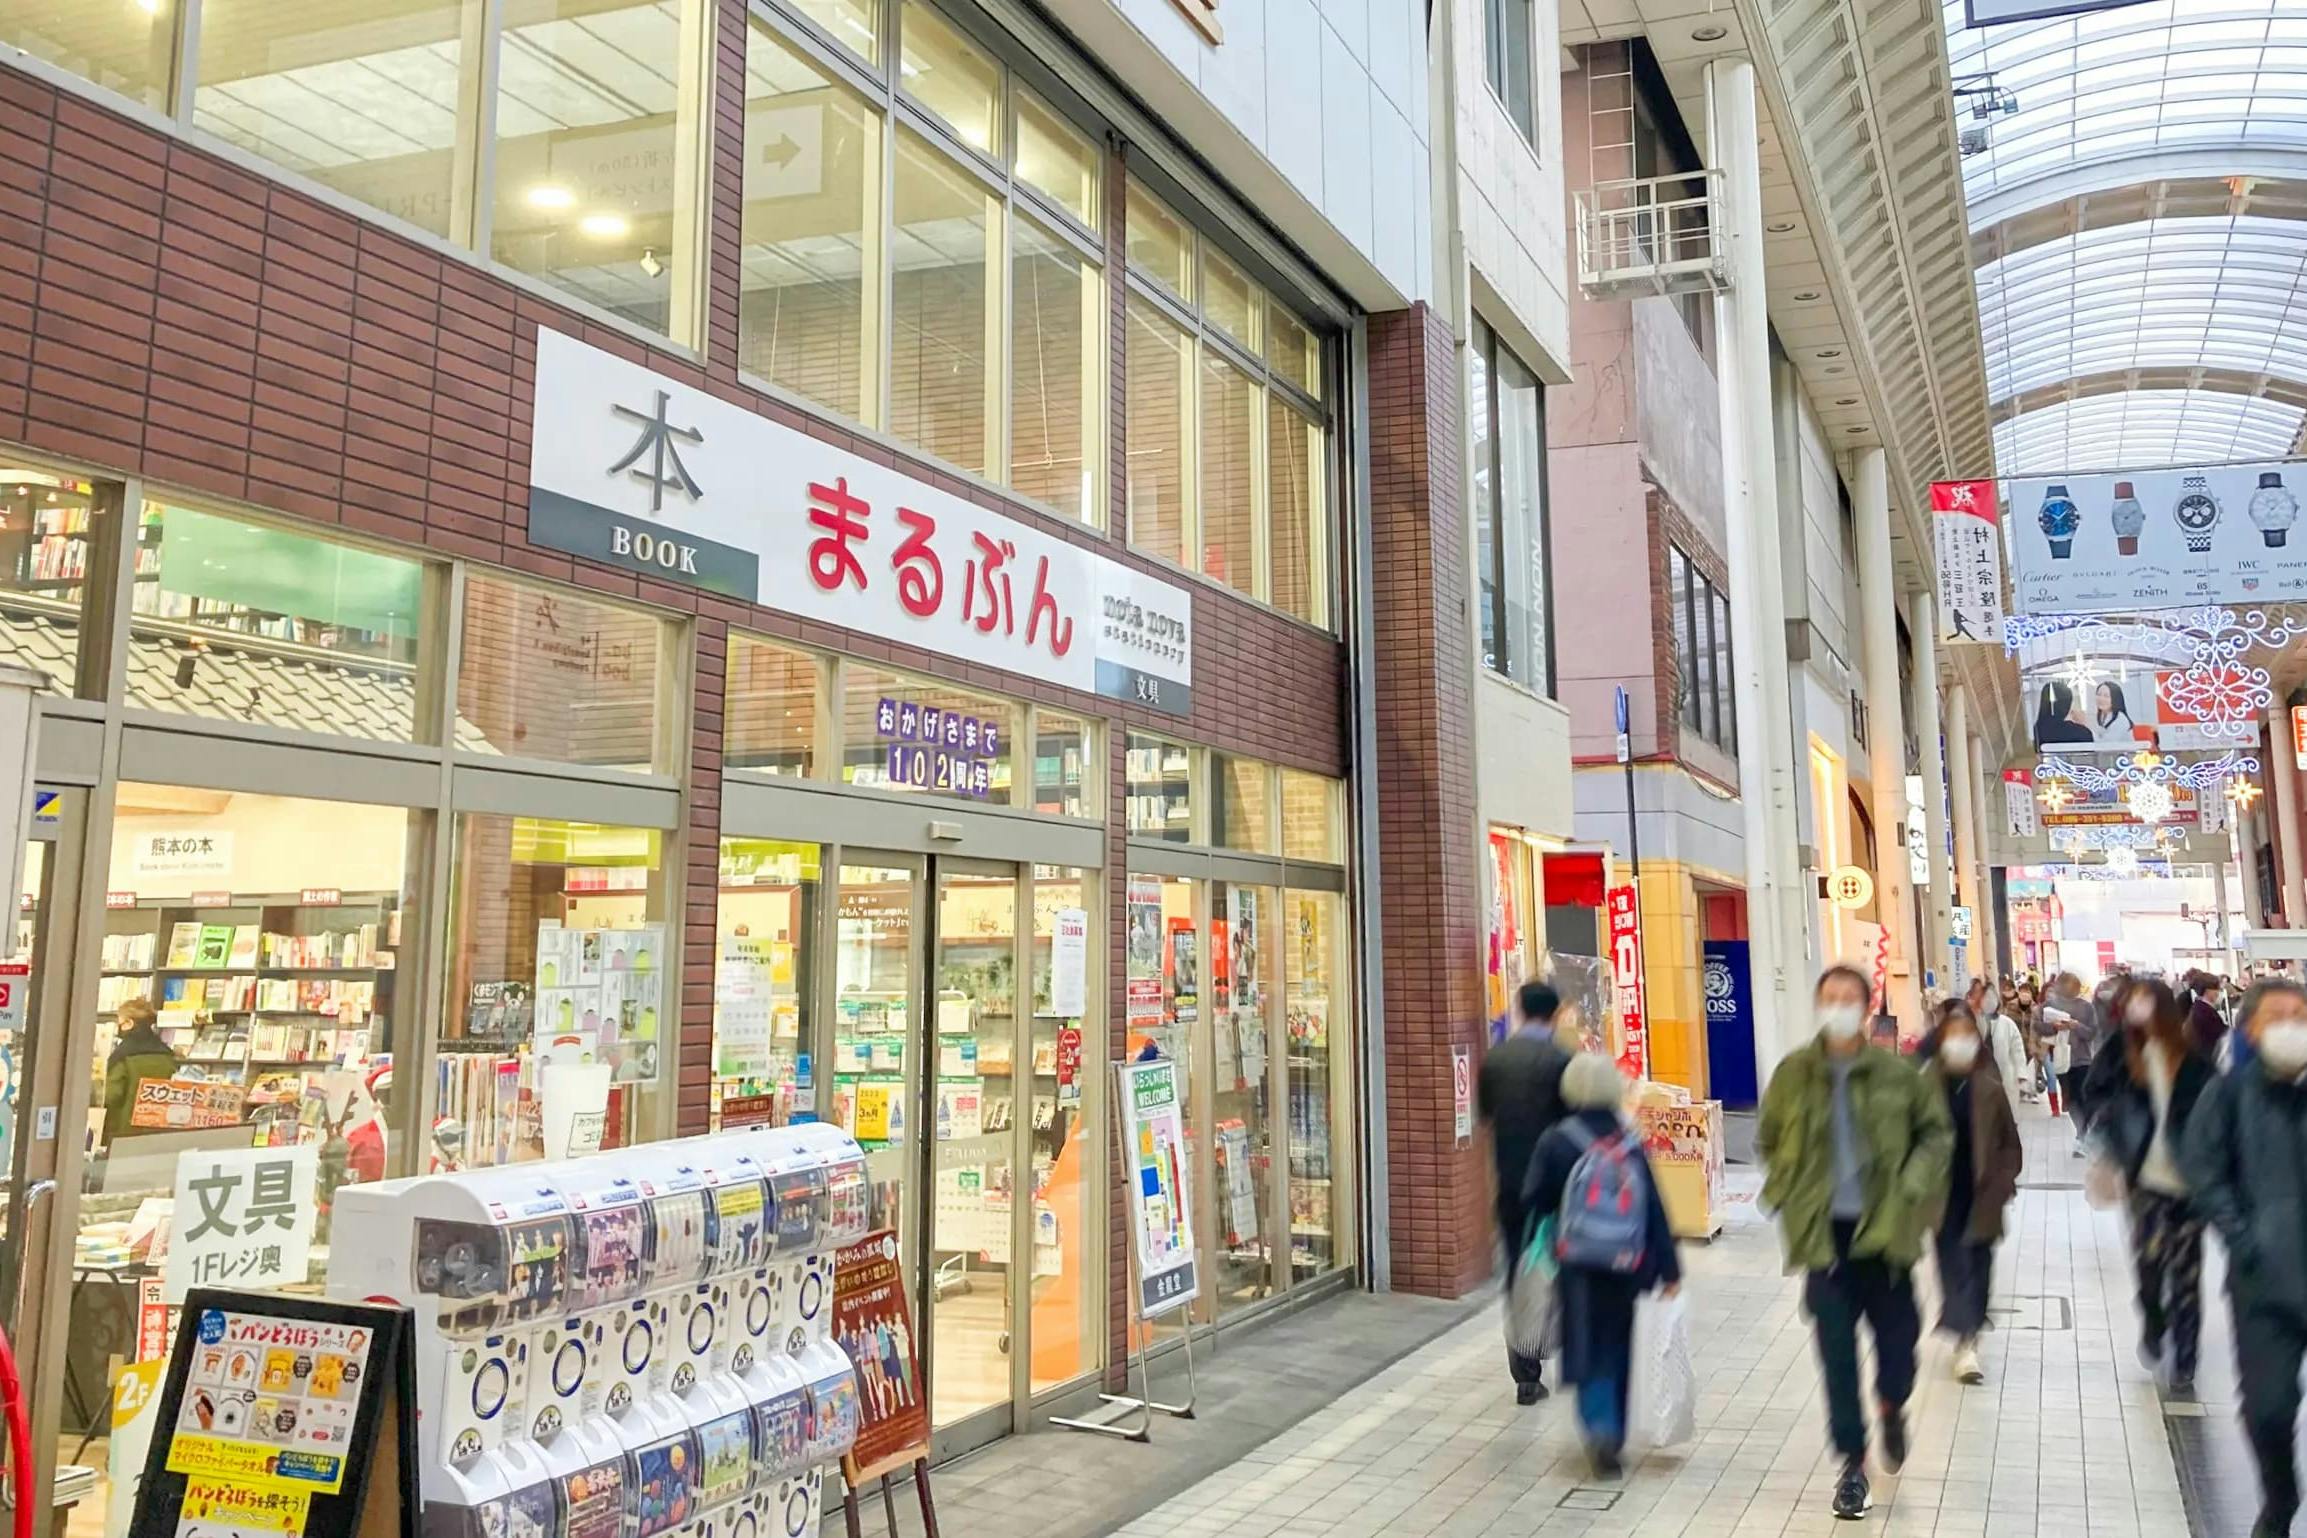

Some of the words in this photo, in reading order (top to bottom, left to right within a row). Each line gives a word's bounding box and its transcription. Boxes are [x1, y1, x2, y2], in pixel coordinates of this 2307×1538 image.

[608, 389, 703, 511] 本
[610, 526, 698, 575] BOOK
[808, 477, 1071, 657] まるぶん
[2022, 571, 2063, 583] Cartier
[2238, 560, 2258, 570] IWC
[1972, 526, 1996, 638] 村上宗隆選手
[2133, 588, 2168, 598] ZENITH
[1103, 595, 1144, 629] nota
[2028, 595, 2060, 604] OMEGA
[1136, 675, 1159, 704] 文具
[880, 703, 997, 753] おかげさまで
[894, 746, 987, 793] 102周年
[150, 836, 214, 857] 熊本の本
[1706, 1000, 1737, 1013] OSS
[142, 1083, 204, 1105] スウェット
[1137, 1087, 1173, 1107] WELCOME
[184, 1159, 298, 1244] 文具
[192, 1245, 282, 1284] 1Fレジ奥
[240, 1321, 320, 1348] パンどろぼう
[119, 1371, 149, 1410] 2F
[175, 1438, 214, 1453] オリジナル
[174, 1451, 266, 1473] マイクロファイバータオル
